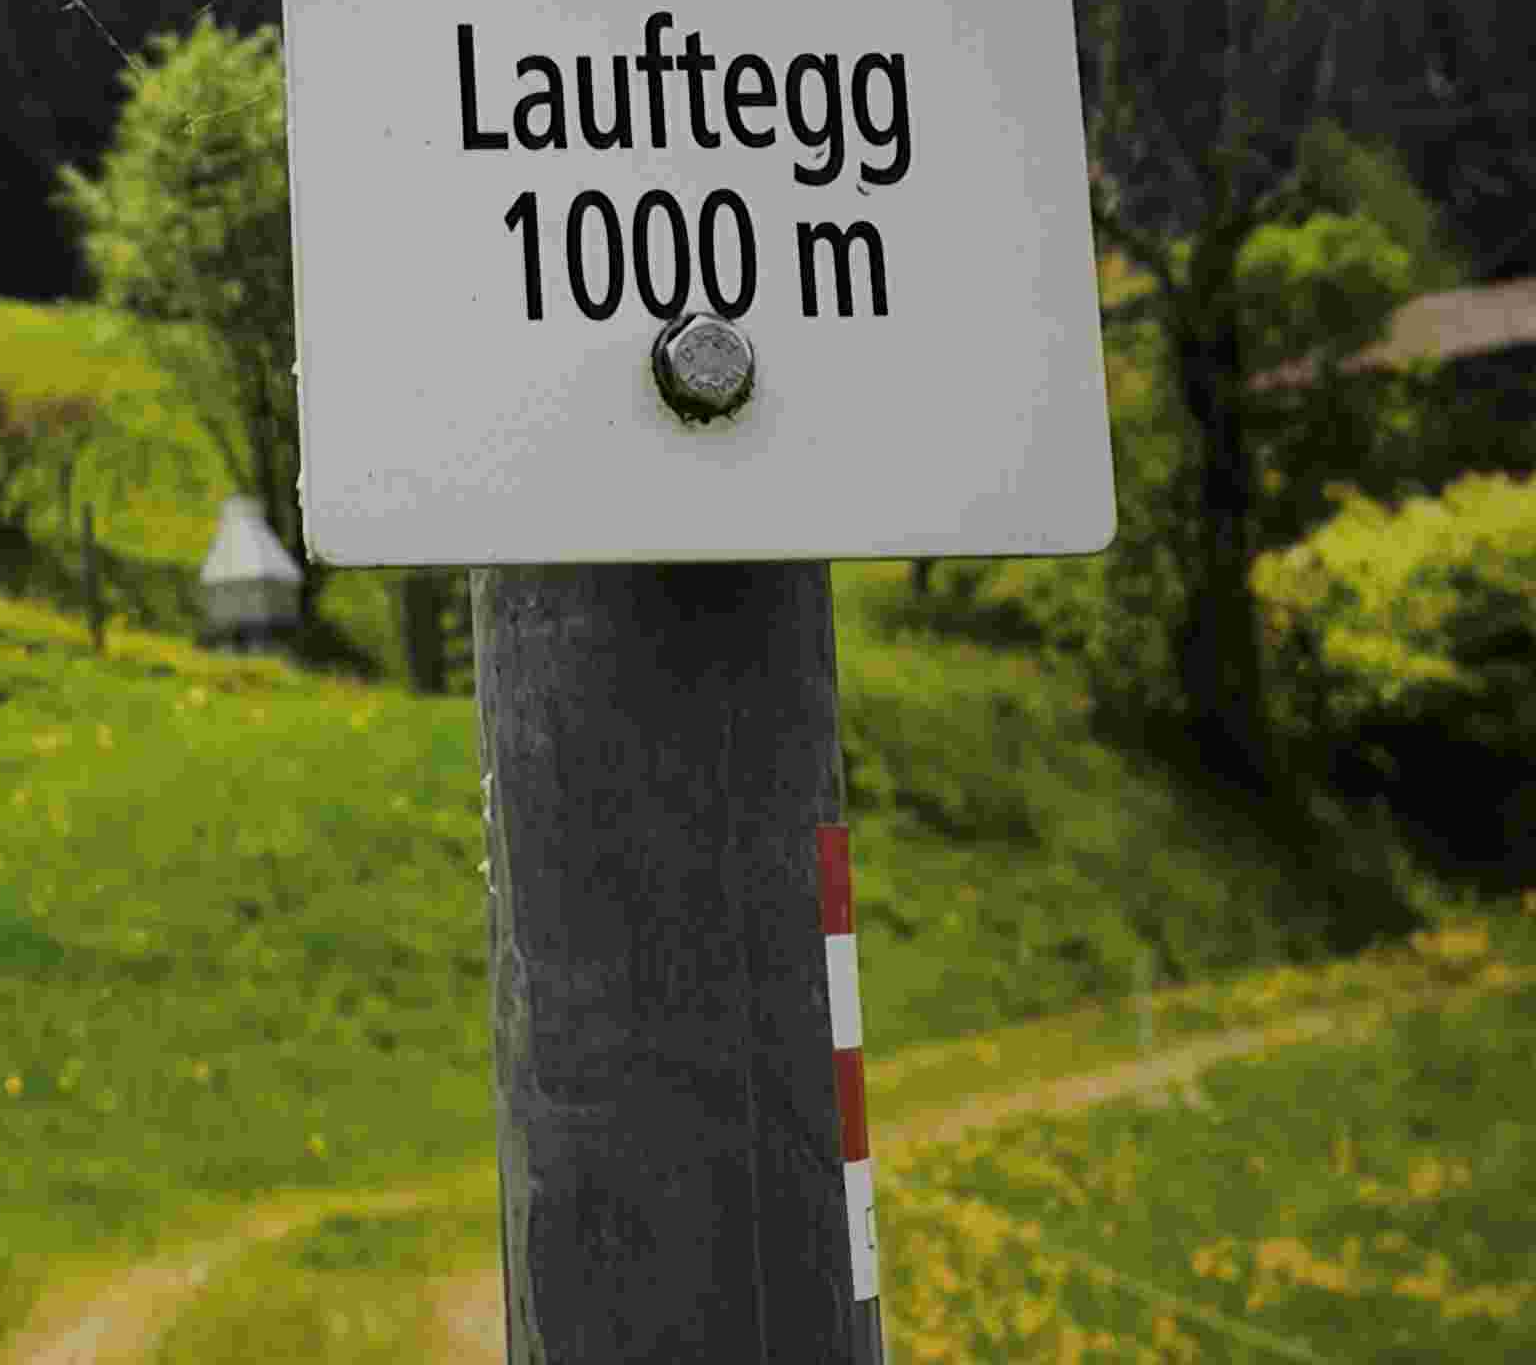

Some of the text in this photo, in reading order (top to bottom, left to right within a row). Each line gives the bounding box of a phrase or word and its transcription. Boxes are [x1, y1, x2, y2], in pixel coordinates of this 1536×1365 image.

[457, 11, 913, 187] Lauftegg
[503, 187, 888, 321] 1000 m
